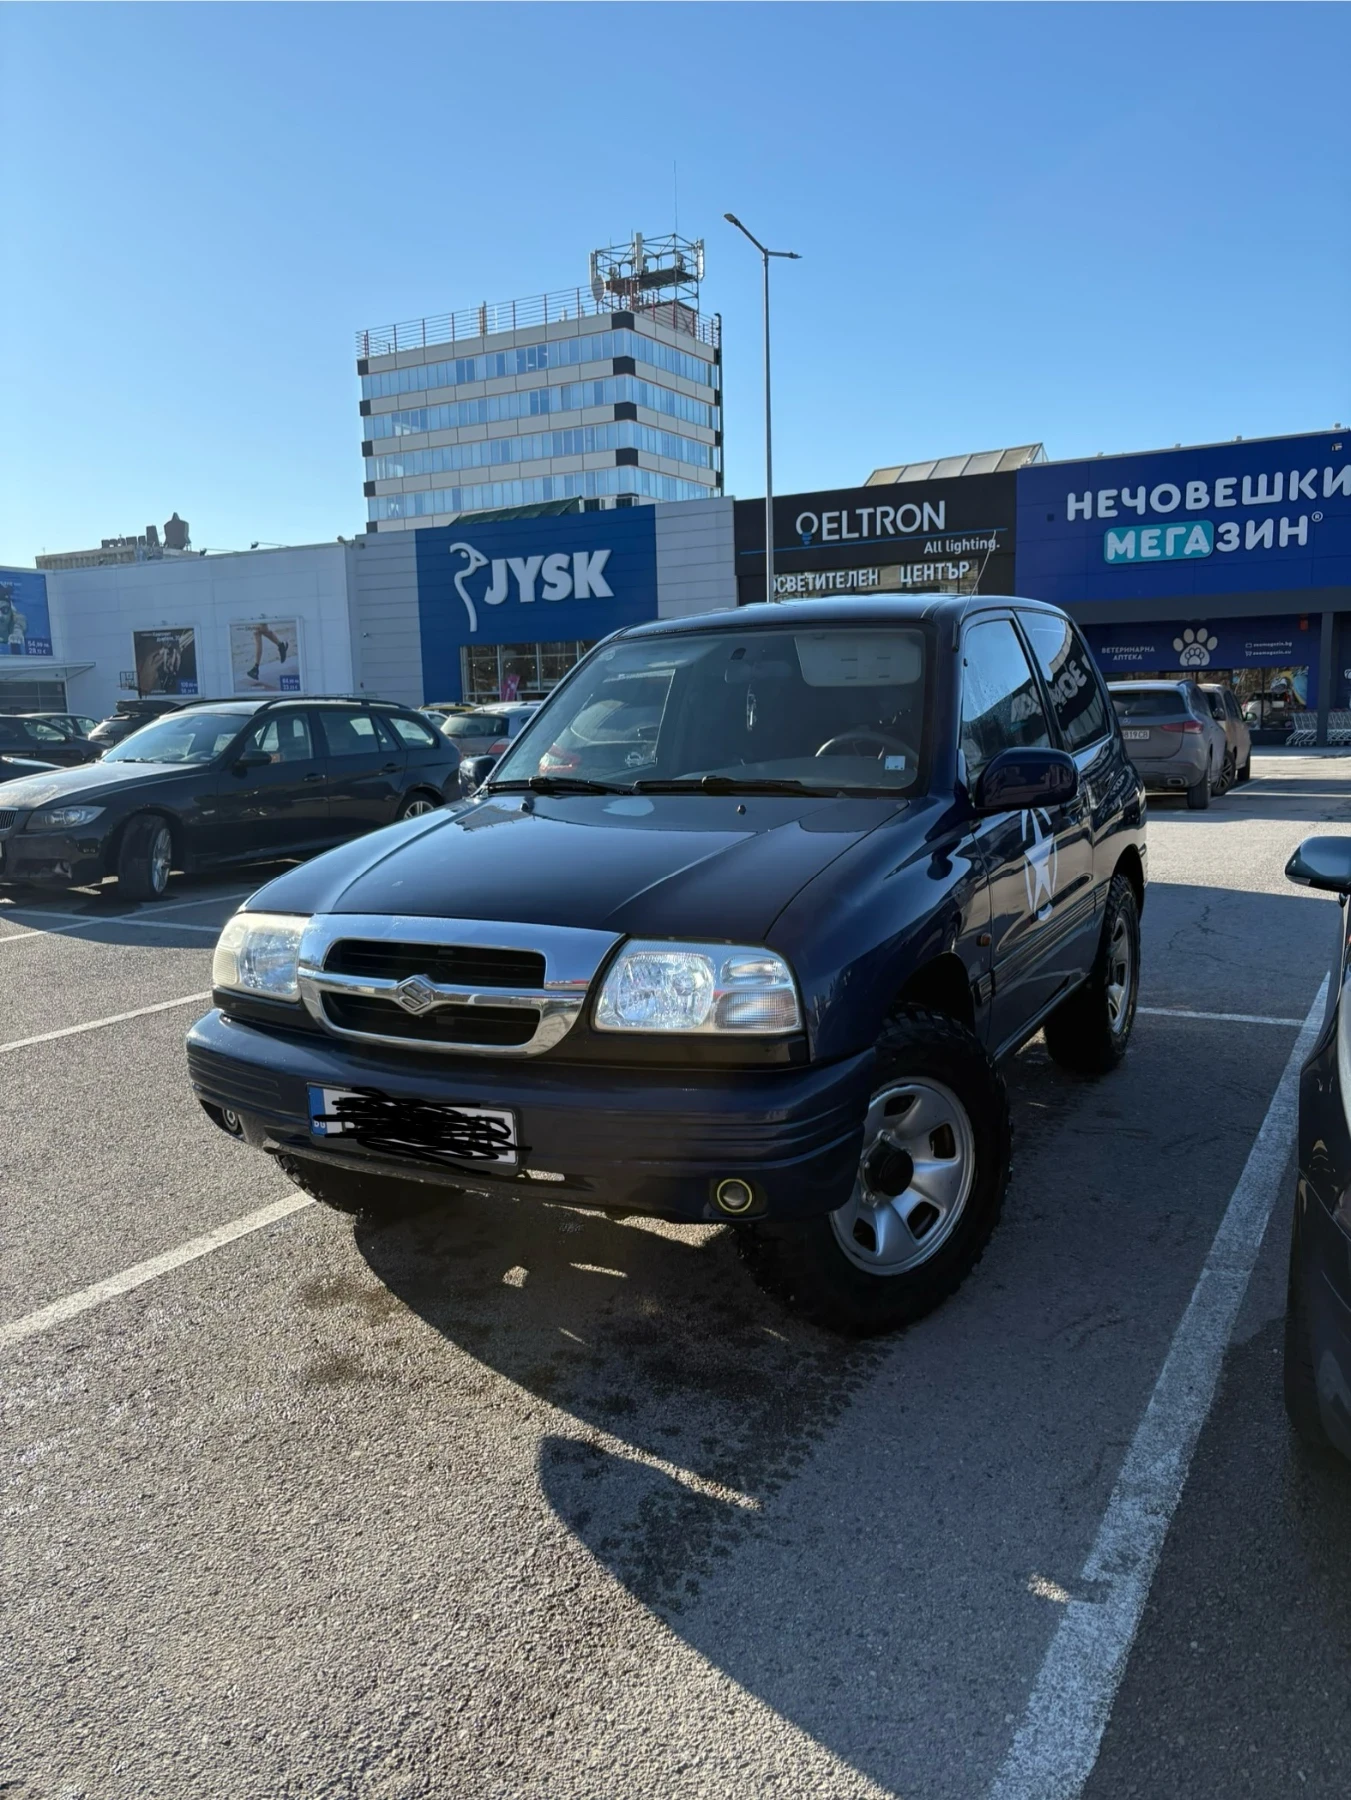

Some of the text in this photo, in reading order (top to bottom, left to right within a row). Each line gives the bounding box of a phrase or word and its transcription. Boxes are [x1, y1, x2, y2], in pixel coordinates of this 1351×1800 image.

[1067, 464, 1351, 521] НЕЧОВЕШКИ
[923, 537, 1001, 555] All lighting.
[484, 549, 615, 605] JYSK
[900, 560, 970, 585] ЦЕНТЪР
[1101, 646, 1156, 655] ВЕТЕРИНАРНА
